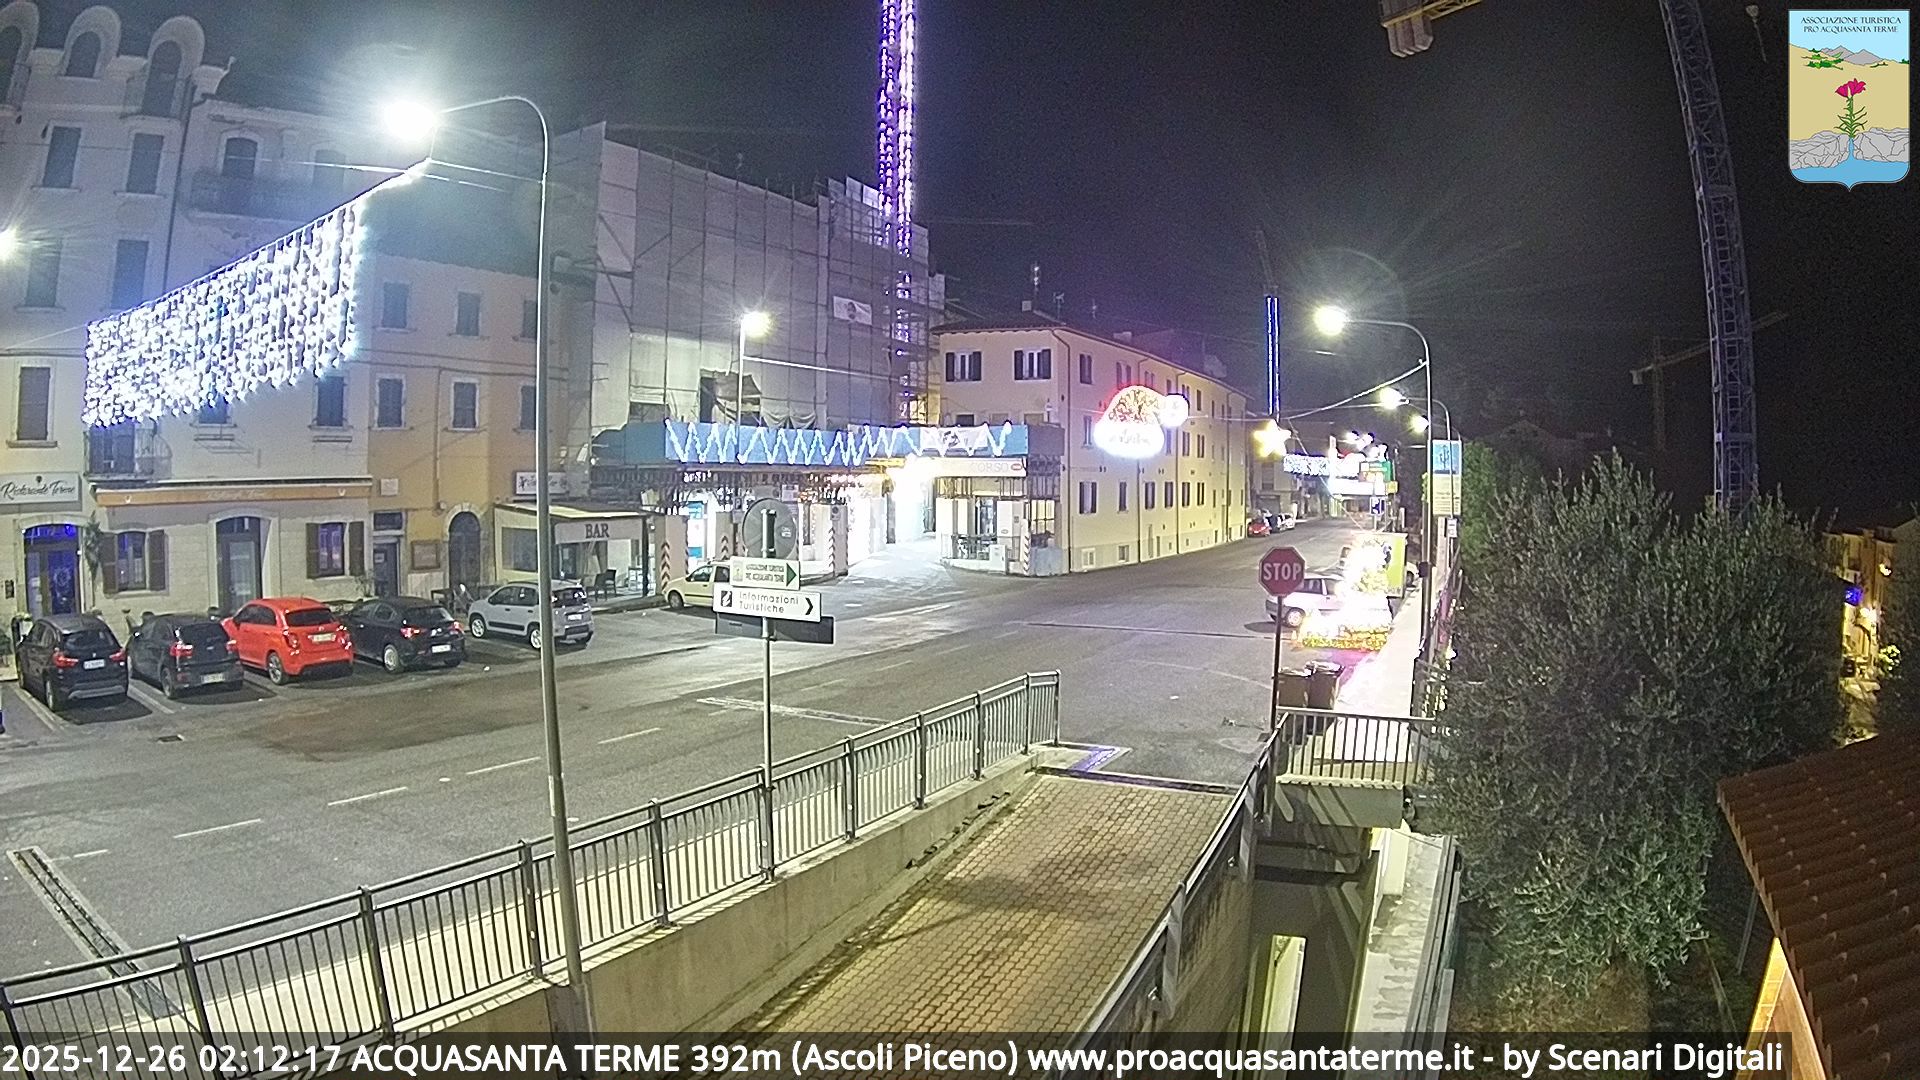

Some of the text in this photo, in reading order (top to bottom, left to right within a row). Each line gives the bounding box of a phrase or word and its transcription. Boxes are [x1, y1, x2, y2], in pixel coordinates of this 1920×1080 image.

[585, 523, 610, 539] BAR
[1263, 562, 1302, 581] STOP
[740, 592, 799, 605] Informazioni
[740, 601, 784, 614] Turistiche
